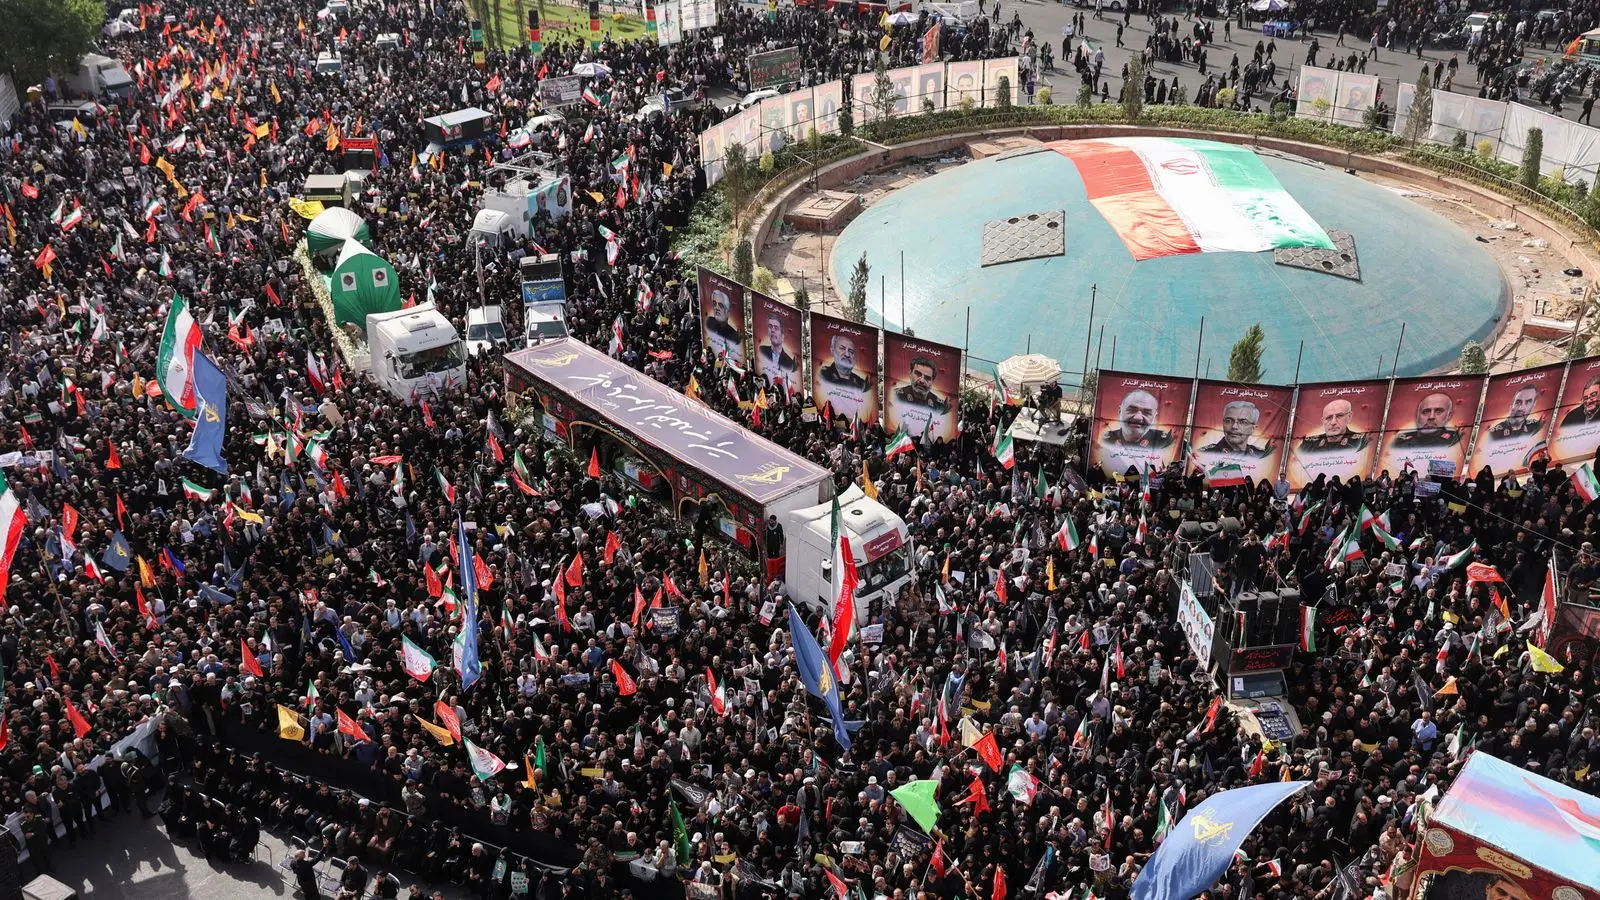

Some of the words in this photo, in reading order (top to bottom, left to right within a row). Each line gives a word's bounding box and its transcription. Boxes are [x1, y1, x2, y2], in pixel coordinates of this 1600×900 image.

[1587, 361, 1600, 370] تدار
[1120, 379, 1139, 387] اقتدار
[1139, 380, 1154, 388] مظهر
[1154, 382, 1169, 390] شهدا
[1415, 383, 1432, 391] اقتدار
[1432, 382, 1447, 390] مظهر
[1447, 381, 1461, 389] شهدا
[1220, 388, 1239, 396] اقتدار
[1239, 389, 1254, 397] مظهر
[1254, 391, 1269, 399] شهدا
[1320, 388, 1337, 397] اقتدار
[1337, 387, 1351, 396] مظهر
